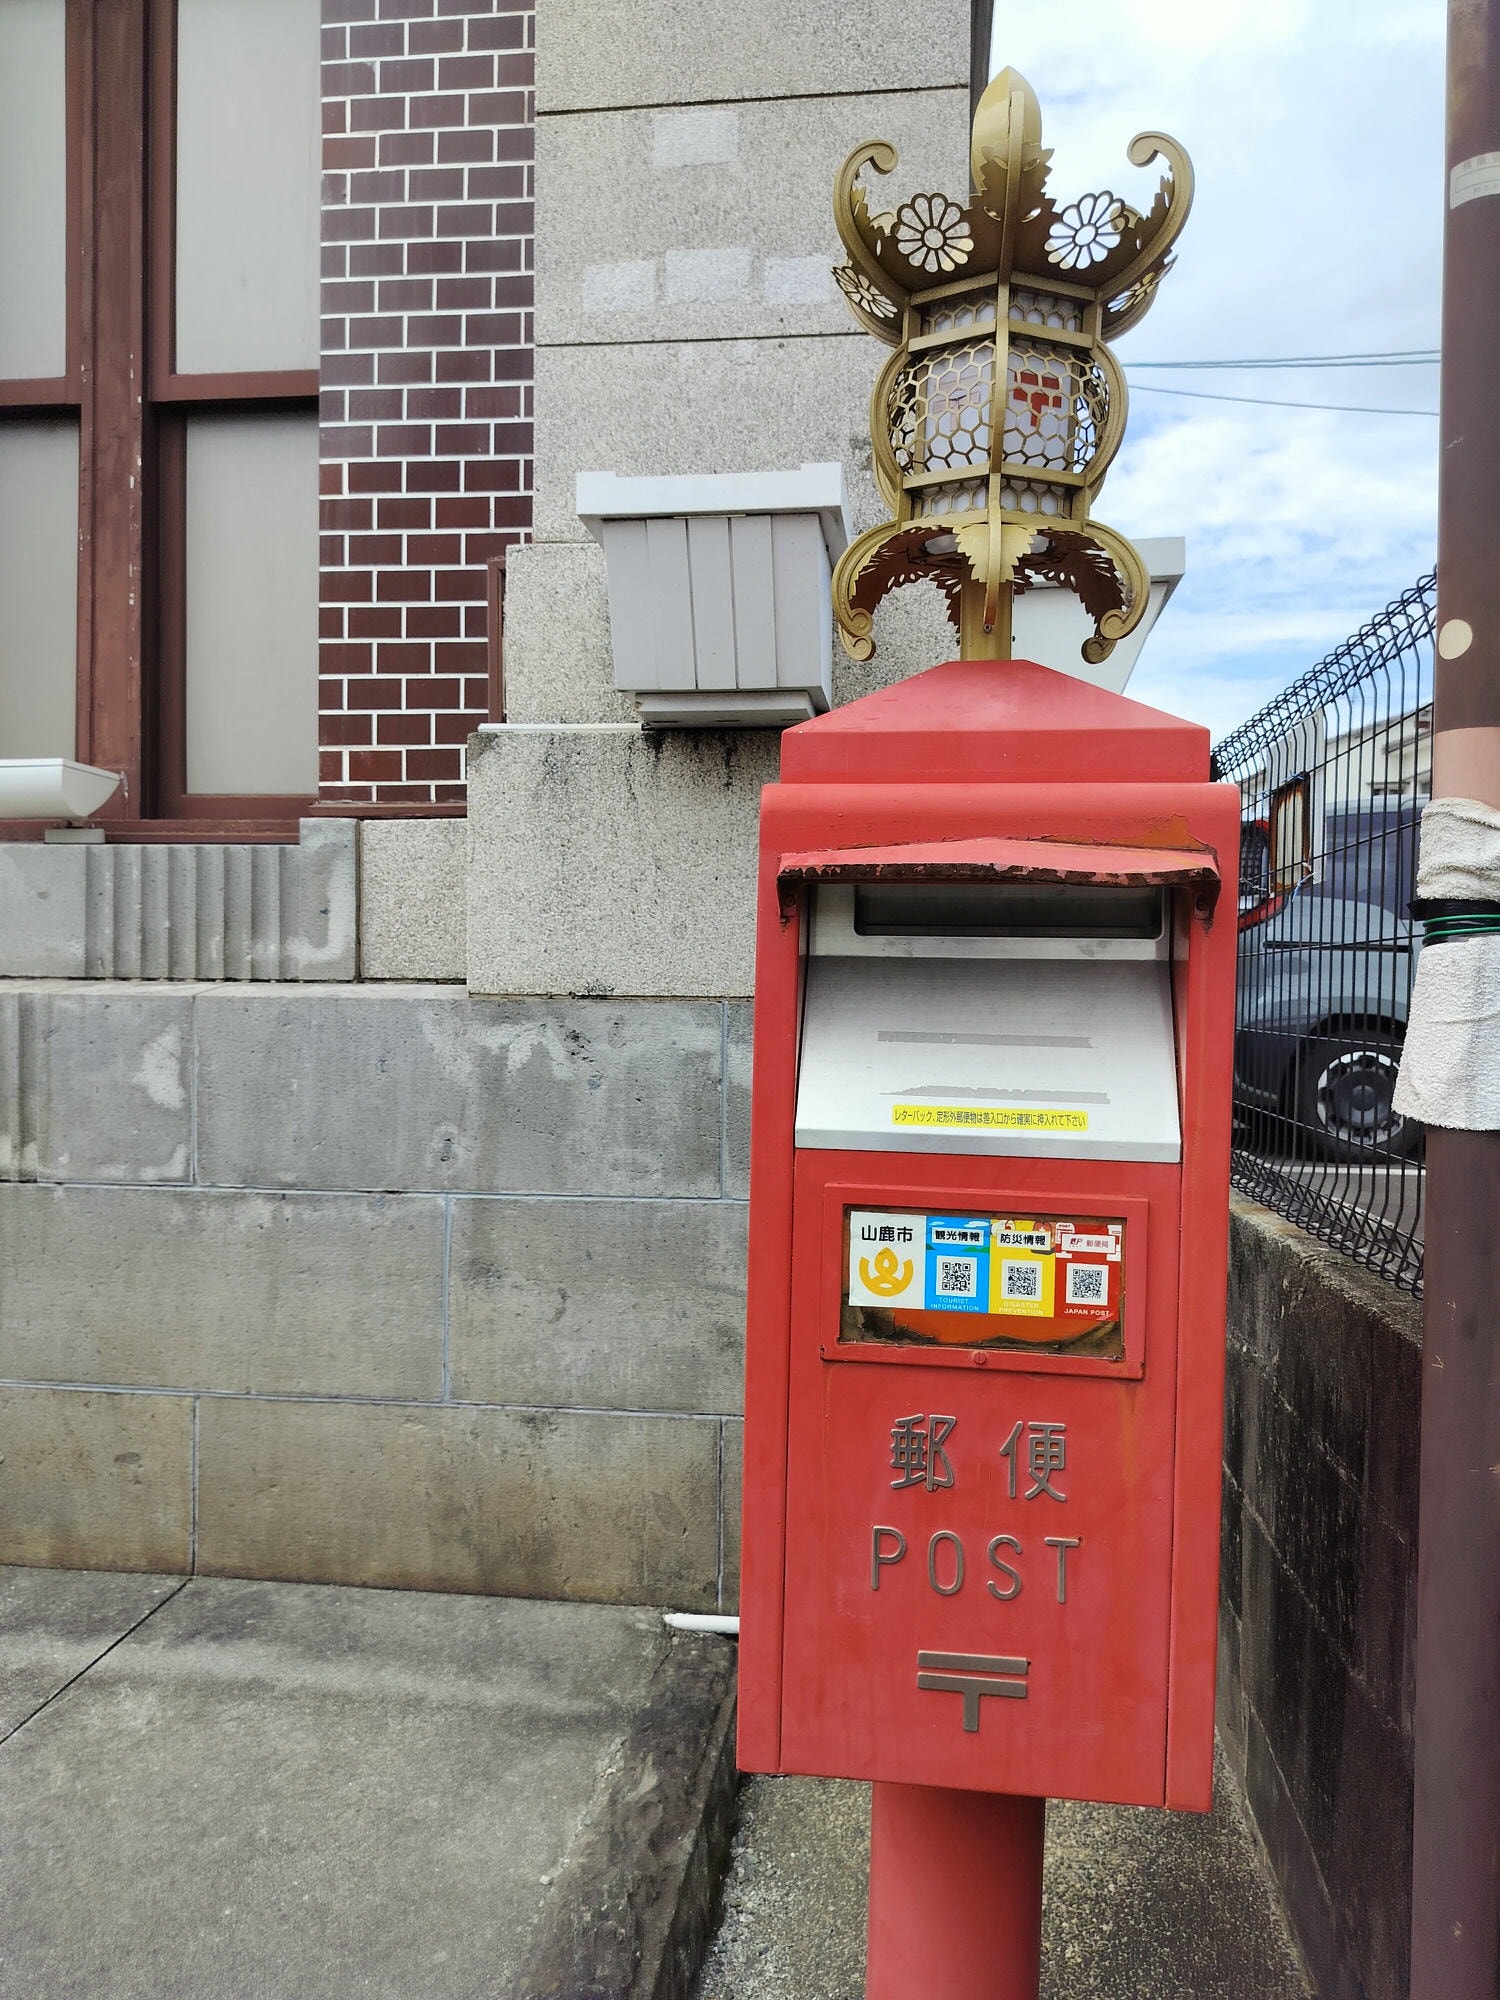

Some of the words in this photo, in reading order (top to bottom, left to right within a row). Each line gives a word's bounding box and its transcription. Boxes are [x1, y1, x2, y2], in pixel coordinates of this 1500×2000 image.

[861, 1225, 914, 1243] 山鹿市
[935, 1230, 980, 1242] 観光情報
[1000, 1233, 1046, 1246] 防災情報
[930, 1303, 980, 1311] INFORMATION
[1003, 1301, 1040, 1309] DISASTER
[998, 1307, 1044, 1316] PREVENTION
[889, 1413, 1068, 1502] 郵便
[871, 1525, 1081, 1604] POST
